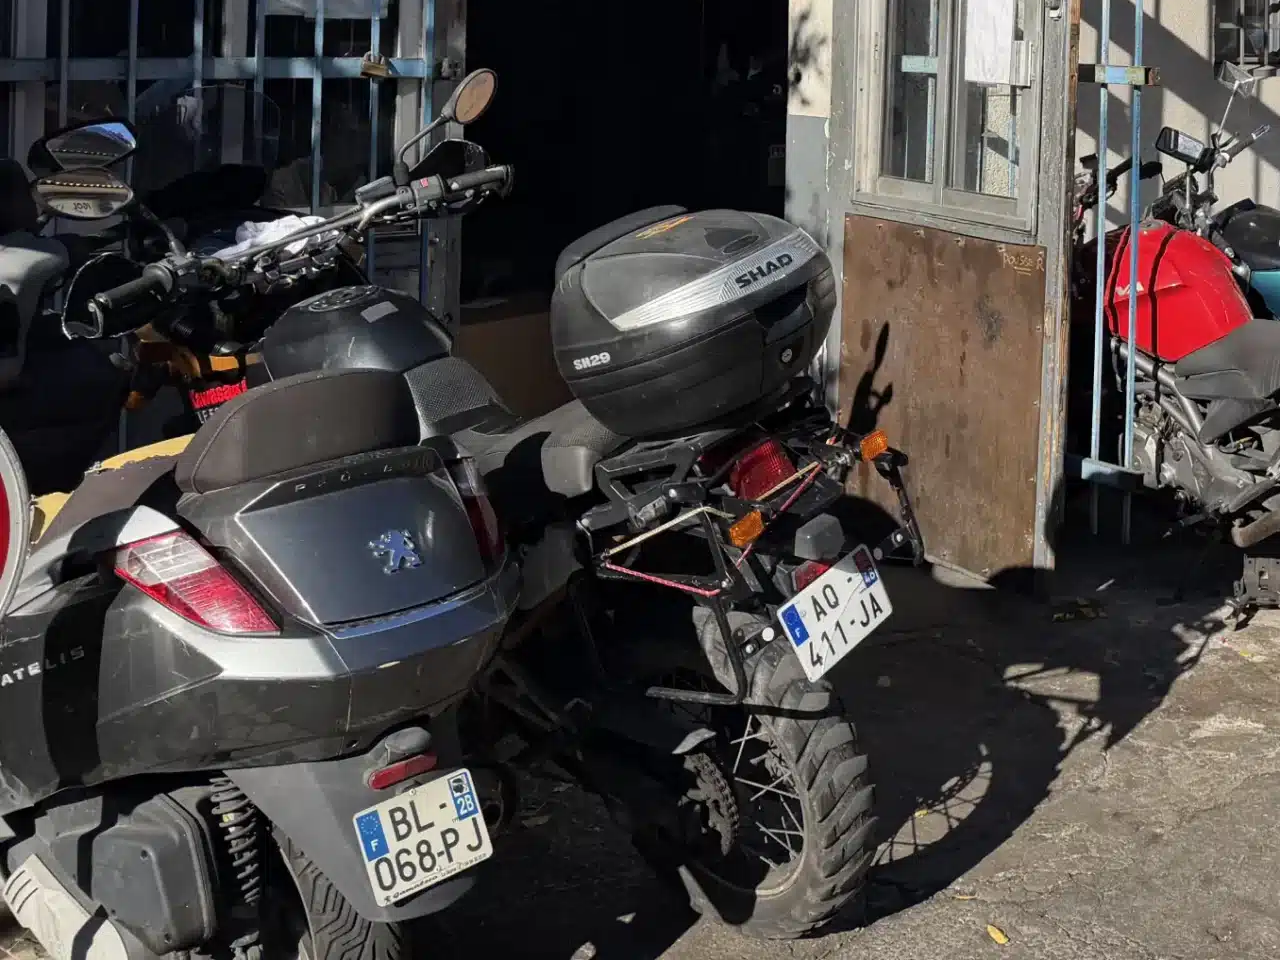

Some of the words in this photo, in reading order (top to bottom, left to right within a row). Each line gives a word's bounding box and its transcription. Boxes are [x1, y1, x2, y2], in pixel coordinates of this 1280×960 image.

[734, 253, 793, 289] SHAD
[573, 351, 611, 370] SH29
[794, 628, 802, 638] F
[809, 592, 883, 667] 411-JA
[456, 793, 475, 816] 2B
[370, 838, 379, 852] F
[374, 817, 483, 892] 068-PJ
